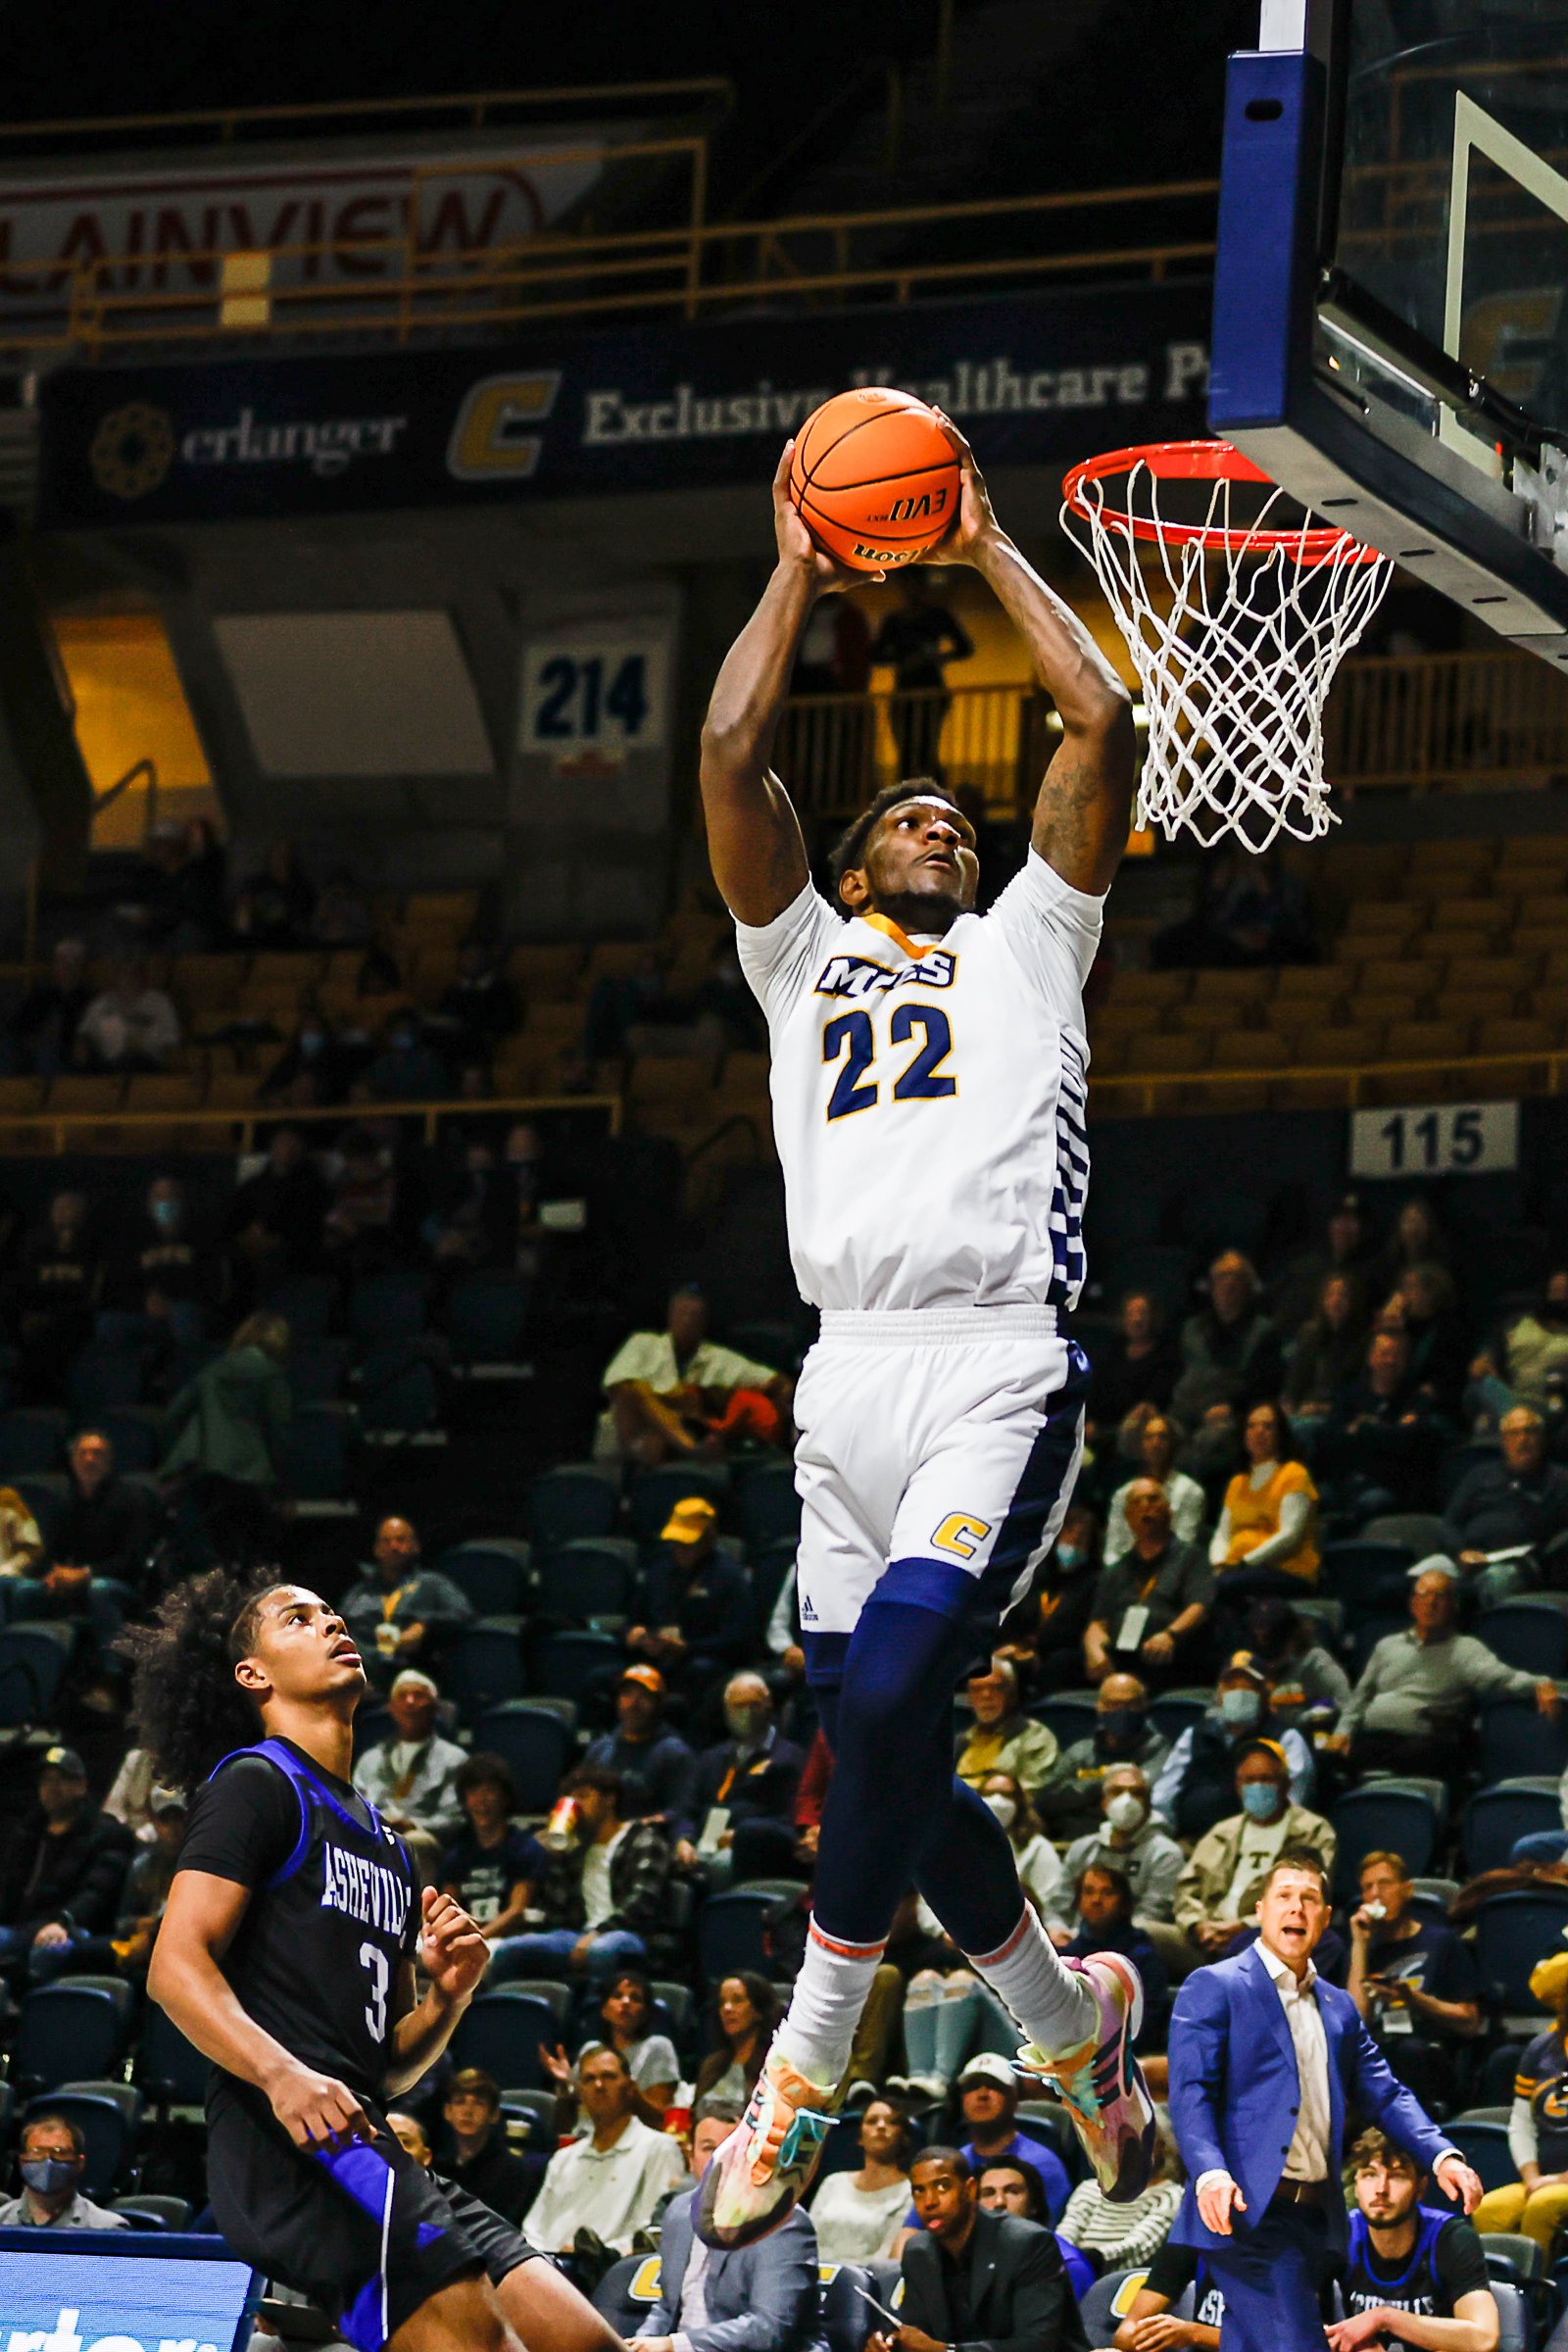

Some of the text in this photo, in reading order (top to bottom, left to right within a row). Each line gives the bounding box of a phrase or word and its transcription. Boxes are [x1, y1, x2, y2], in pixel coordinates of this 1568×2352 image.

[848, 354, 1148, 416] althcare
[1163, 339, 1211, 401] P
[181, 406, 408, 477] erlanger
[889, 488, 947, 521] EVO
[536, 655, 648, 736] 214
[822, 1003, 959, 1123] 22
[1381, 1109, 1484, 1170] 115
[359, 1941, 390, 2043] 3
